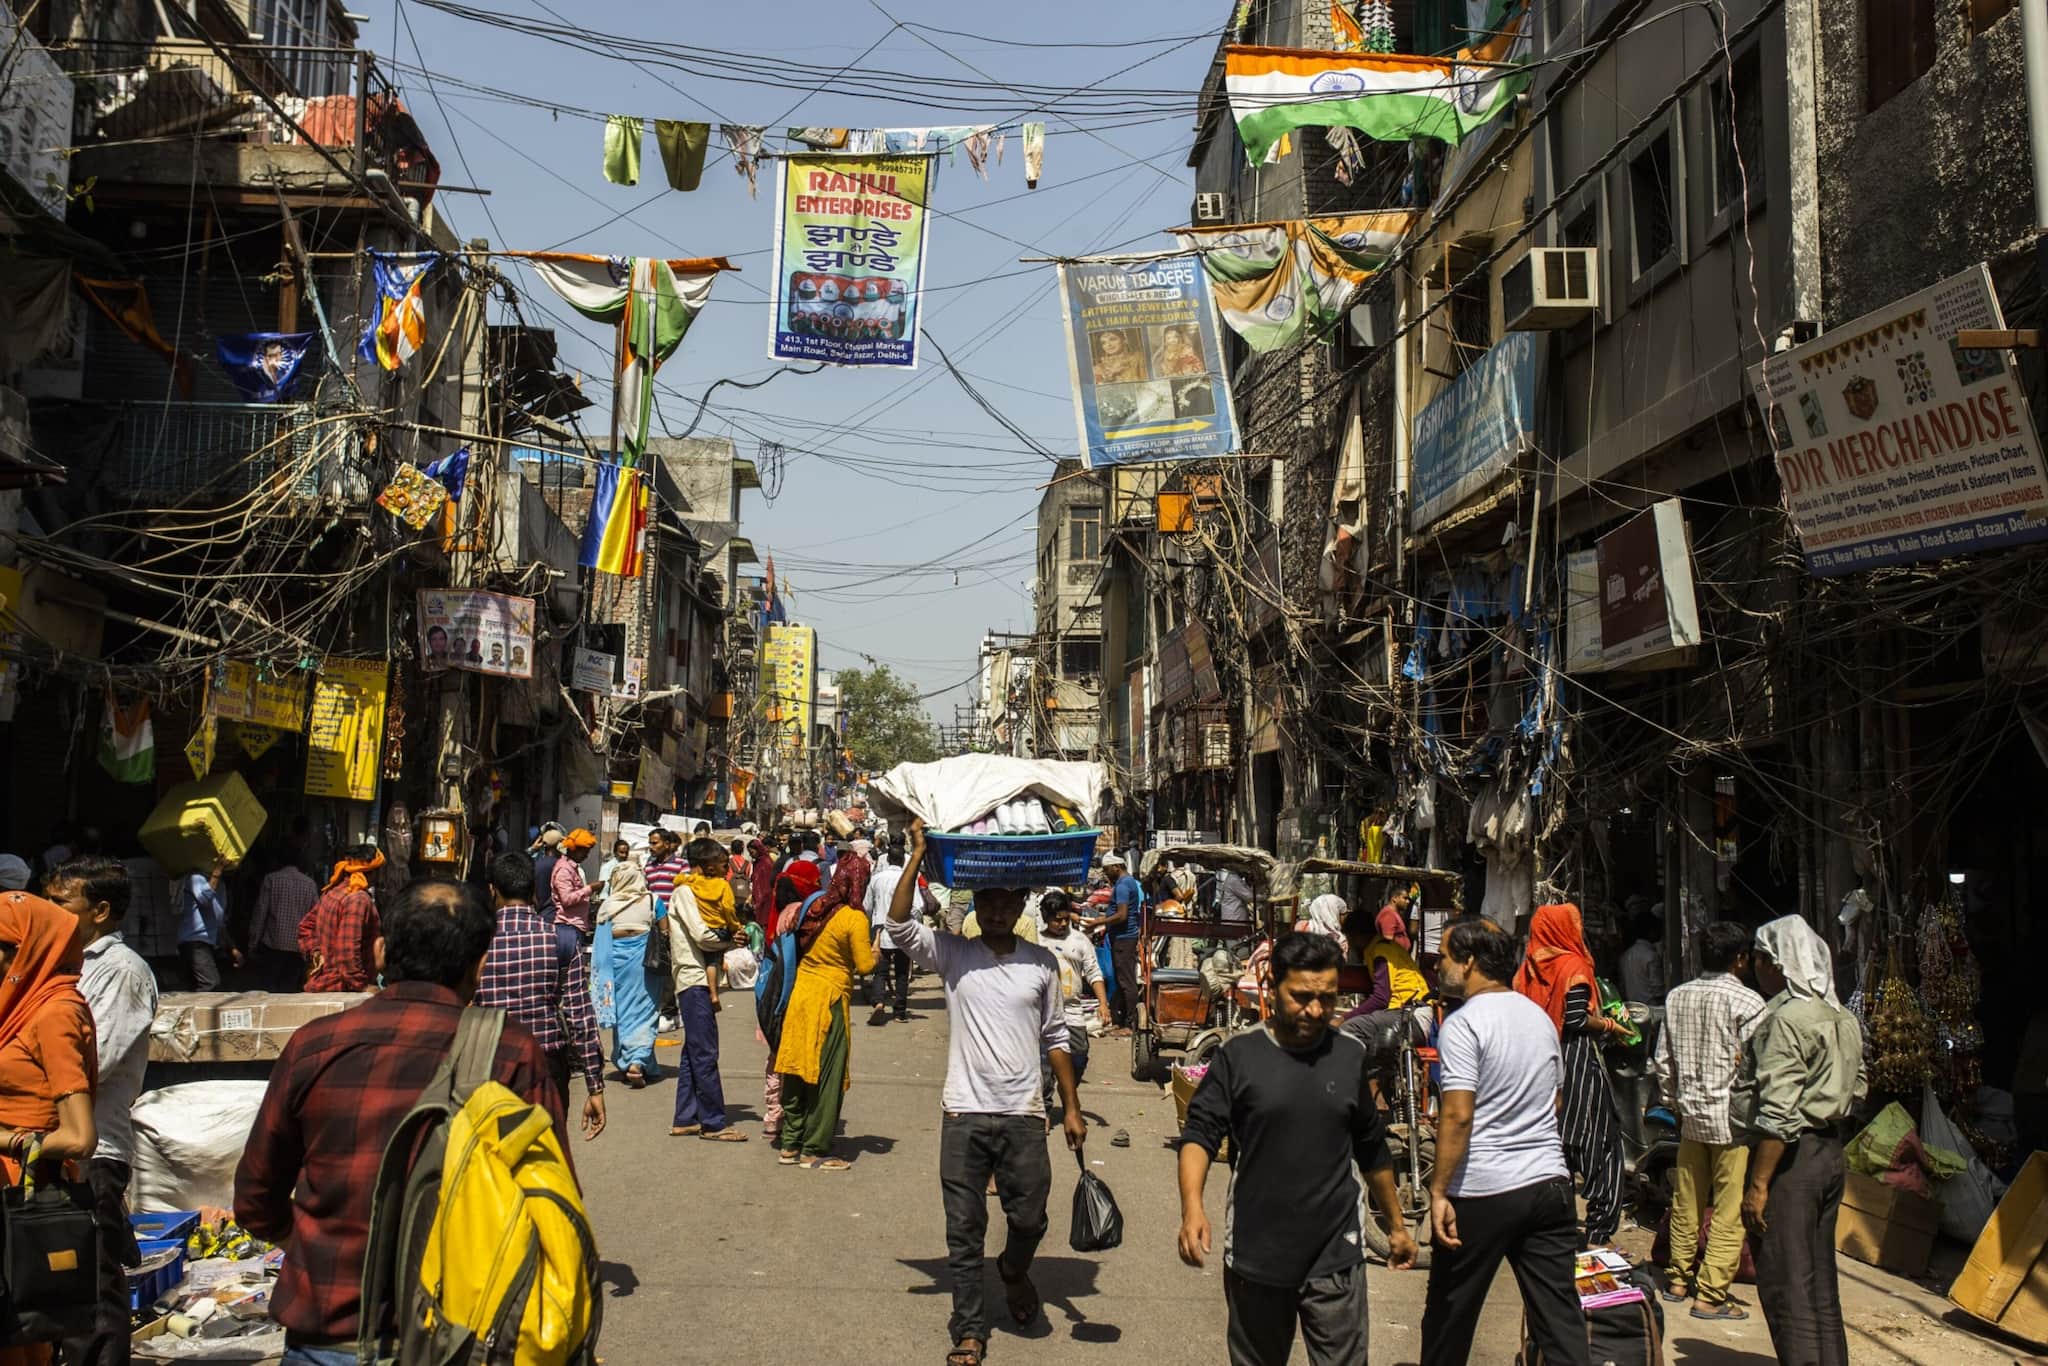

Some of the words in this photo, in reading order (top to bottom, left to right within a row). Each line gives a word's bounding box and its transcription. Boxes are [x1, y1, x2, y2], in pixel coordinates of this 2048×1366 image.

[809, 172, 901, 197] RAHUL
[796, 195, 912, 220] ENTERPRISES
[804, 221, 901, 246] झण्डे
[803, 246, 899, 271] झण्डे
[1077, 274, 1127, 292] VARUN
[1128, 269, 1194, 288] TRADERS
[1081, 304, 1134, 317] ARTIFICIAL
[1086, 318, 1104, 330] ALL
[1106, 315, 1129, 326] HAIR
[1132, 311, 1196, 324] ACCESSORIES
[780, 344, 802, 353] Main
[803, 346, 828, 357] Road,
[878, 351, 908, 360] Delhi-6
[805, 337, 818, 346] 1st
[875, 342, 905, 352] Market
[1781, 448, 1830, 494] DYR
[1828, 387, 2020, 480] MERCHANDISE
[1822, 492, 1832, 505] All
[1830, 490, 1850, 504] Types
[1850, 489, 1857, 498] of
[1857, 482, 1888, 495] Stickers,
[1888, 475, 1908, 489] Photo
[1908, 466, 1935, 483] Printed
[1935, 459, 1971, 477] Pictures,
[1969, 451, 2000, 469] Picture
[2000, 443, 2029, 461] Chart,
[1815, 511, 1846, 526] Envelope,
[1845, 506, 1857, 517] Gift
[1896, 490, 1920, 506] Diwali
[1919, 481, 1961, 500] Decoration
[1961, 478, 1968, 490] &
[1968, 471, 2010, 489] Stationery
[2010, 464, 2037, 480] Items
[1924, 506, 1949, 522] STICKERS
[1968, 495, 2001, 513] WHOLESALE
[2000, 485, 2044, 507] MERCHANDISE
[1833, 551, 1852, 564] Near
[1854, 545, 1872, 560] PNB
[1872, 542, 1898, 557] Bank,
[1897, 537, 1920, 549] Main
[1920, 531, 1945, 548] Road
[1945, 527, 1976, 543] Sadar
[1976, 521, 2009, 537] Bazar,
[354, 661, 385, 673] FOODS
